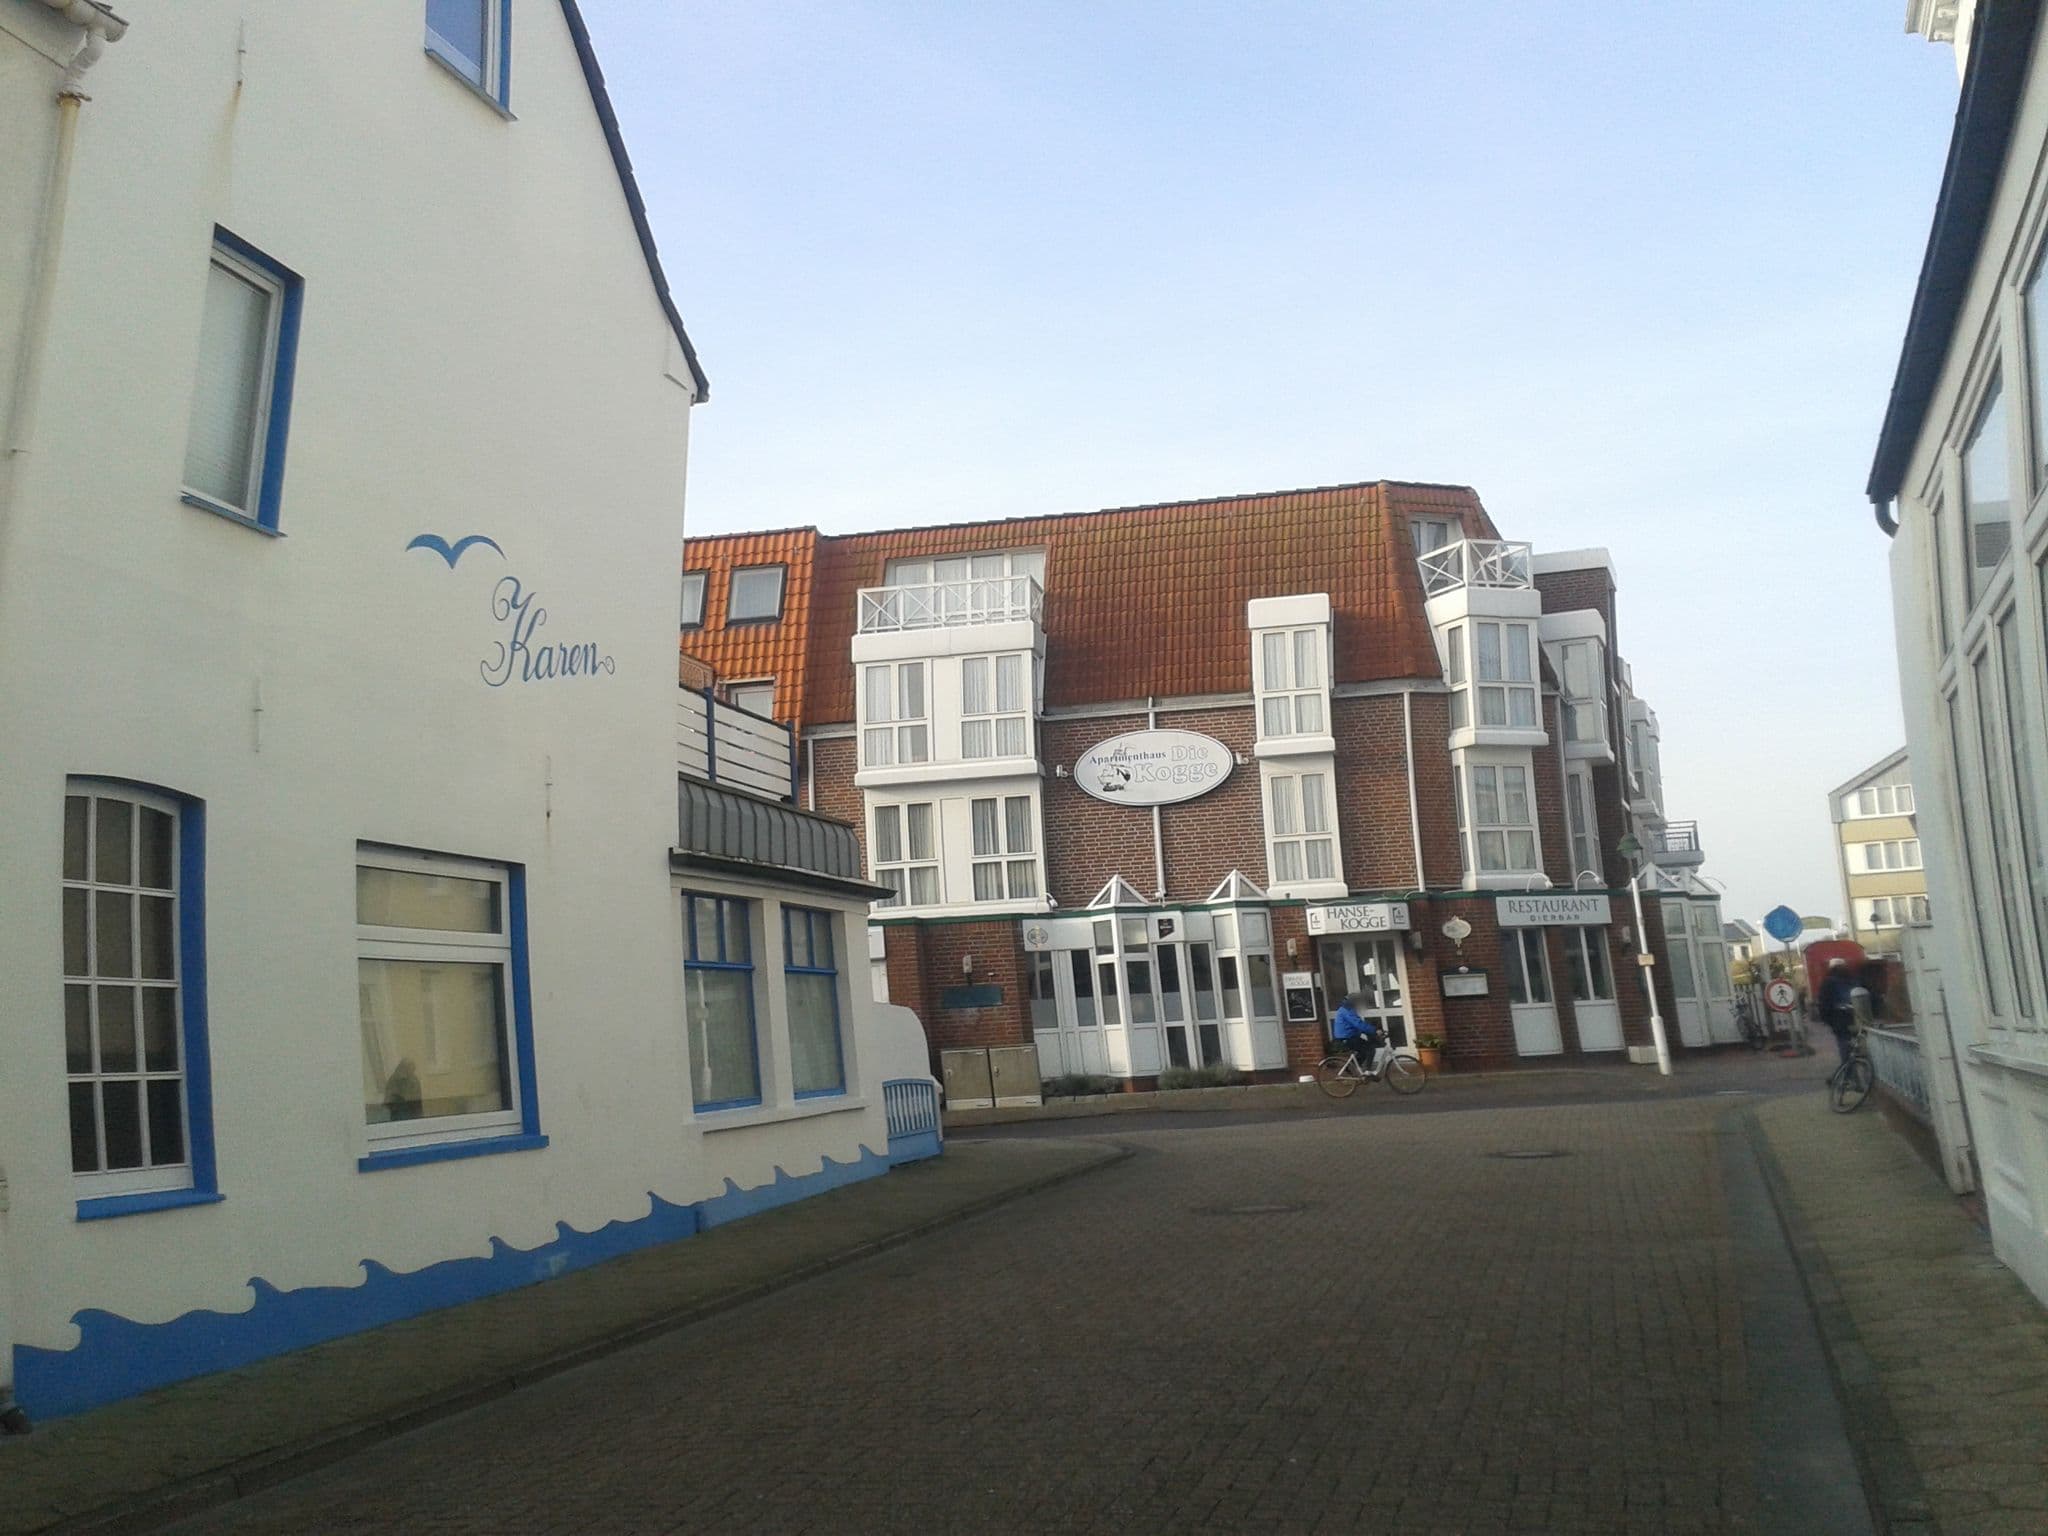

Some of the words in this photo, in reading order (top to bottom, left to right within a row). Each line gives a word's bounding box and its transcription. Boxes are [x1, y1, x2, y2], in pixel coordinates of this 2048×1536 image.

[480, 576, 616, 687] Karen
[1089, 751, 1166, 766] Apartmenthaus
[1170, 745, 1207, 762] Die
[1134, 762, 1218, 784] Kogge
[1327, 905, 1375, 919] HANSE-
[1508, 898, 1599, 913] RESTAURANT
[1340, 917, 1388, 930] KOGGE
